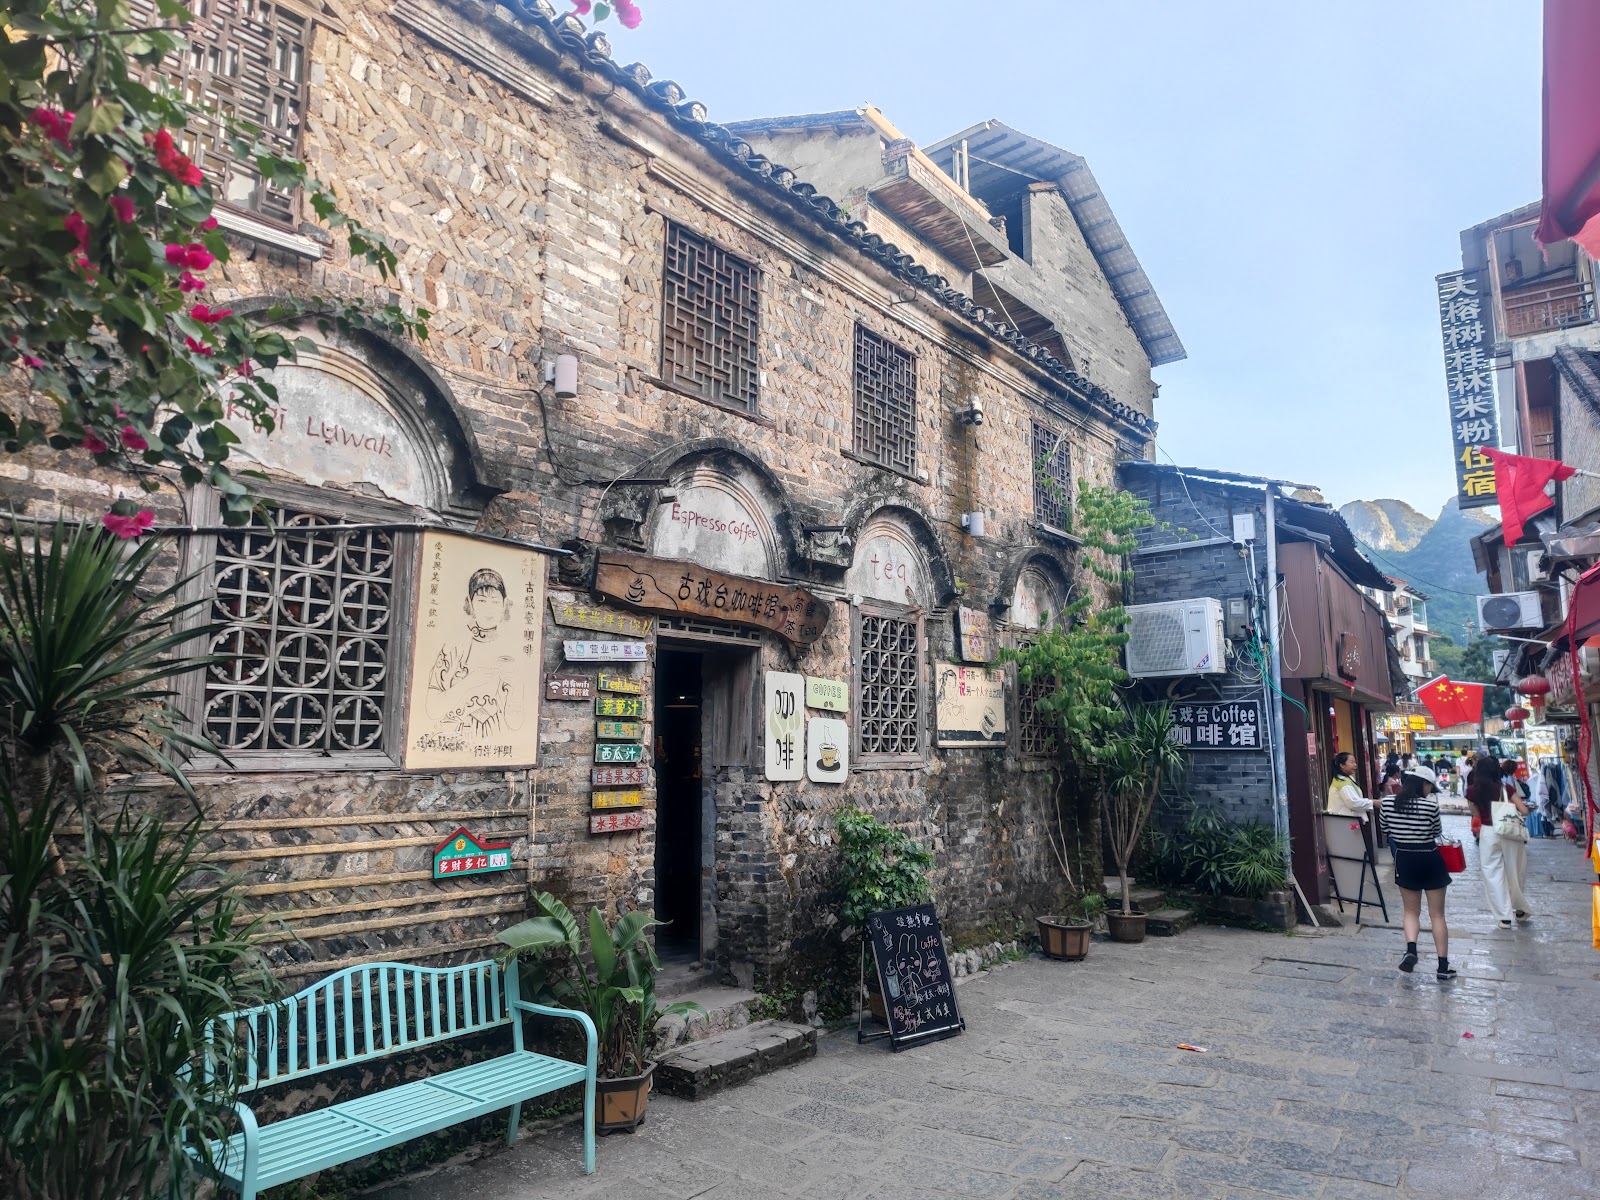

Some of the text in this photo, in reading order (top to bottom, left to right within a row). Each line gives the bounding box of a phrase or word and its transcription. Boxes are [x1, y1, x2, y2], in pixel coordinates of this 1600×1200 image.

[671, 503, 758, 544] Espresso Coffee
[870, 553, 908, 582] tea
[678, 572, 780, 619] 古戏台咖啡馆
[784, 620, 796, 635] 茶
[590, 643, 619, 654] 营业中
[562, 688, 590, 697] 空调开放
[813, 683, 842, 699] COFFEE
[602, 699, 639, 715] 菠萝汁
[603, 723, 638, 737] 芒果汁
[775, 686, 795, 770] 咖啡
[1167, 723, 1257, 745] 咖啡馆
[602, 746, 637, 761] 西瓜汁
[596, 769, 644, 784] 百香果冰茶
[440, 857, 487, 873] 多财多亿
